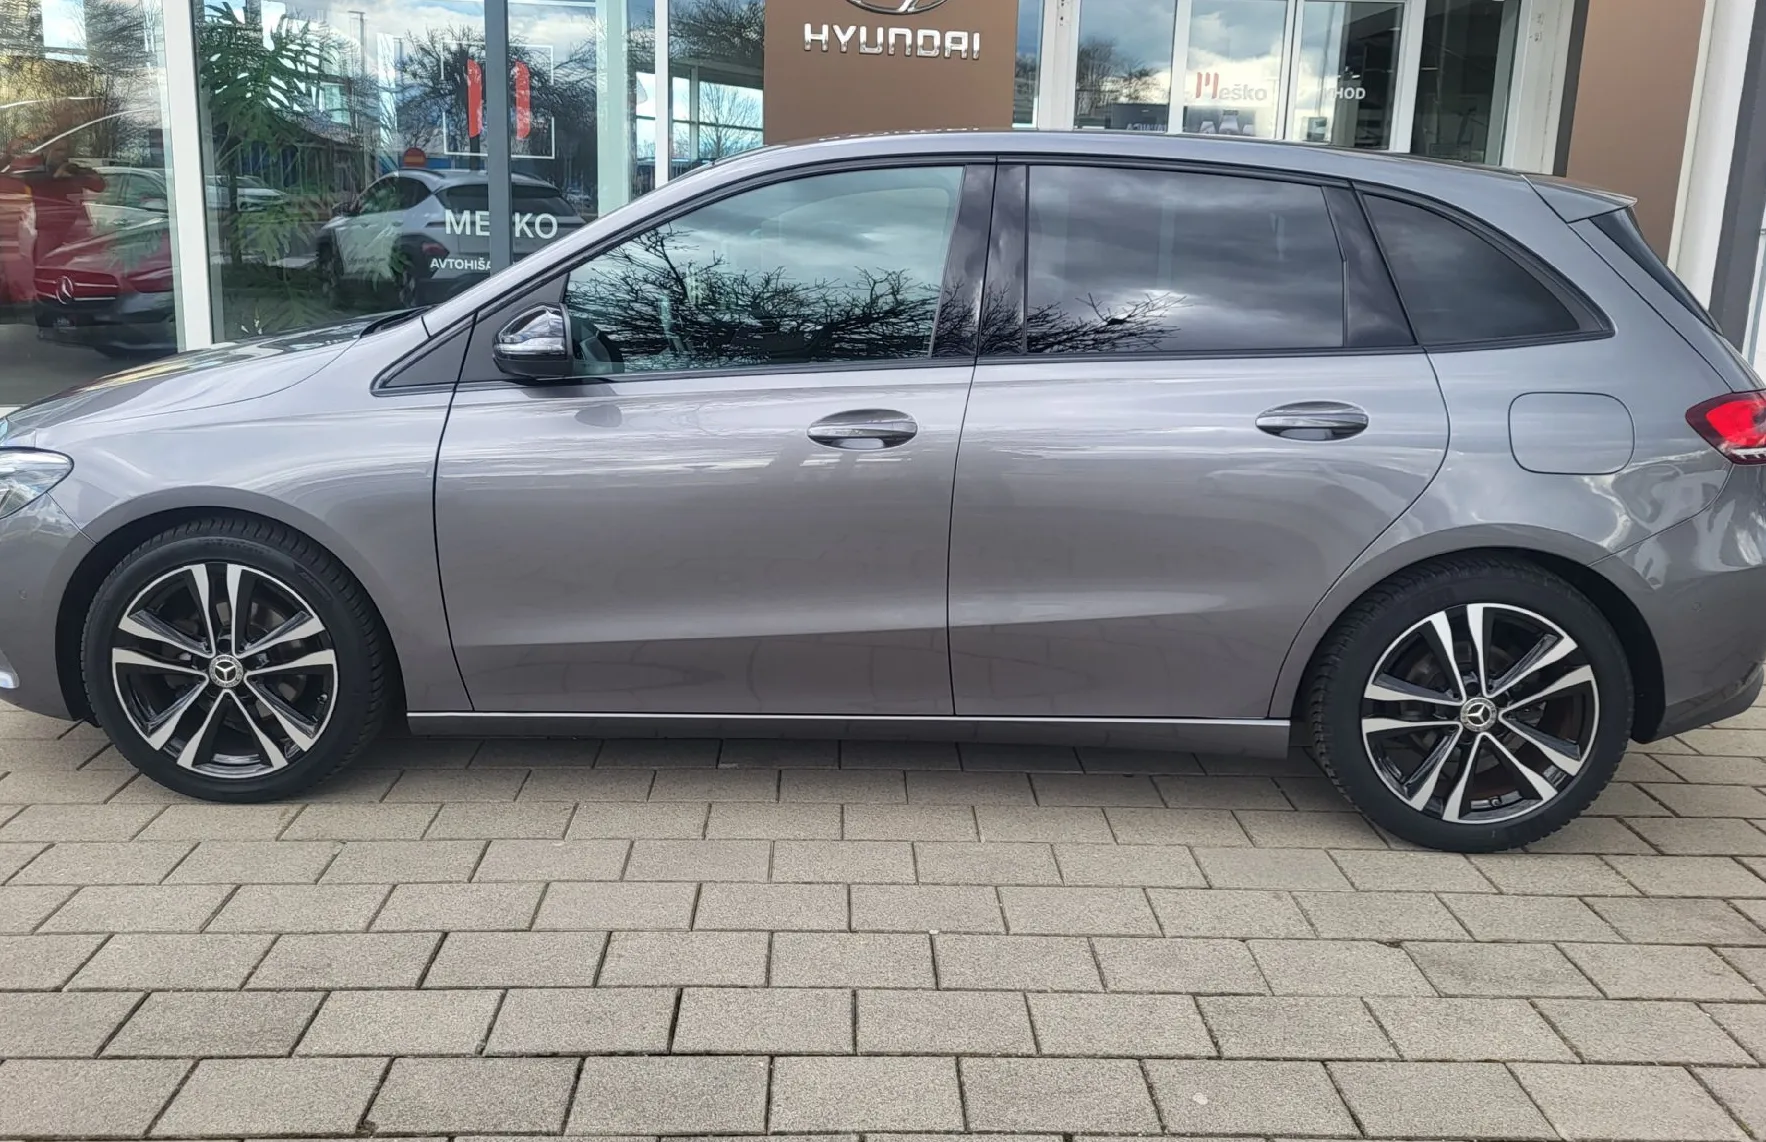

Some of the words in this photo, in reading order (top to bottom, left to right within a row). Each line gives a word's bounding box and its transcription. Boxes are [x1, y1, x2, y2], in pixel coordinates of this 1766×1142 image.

[804, 23, 980, 59] HYUNDAI
[1325, 86, 1366, 100] HOD
[445, 209, 558, 239] MEKO
